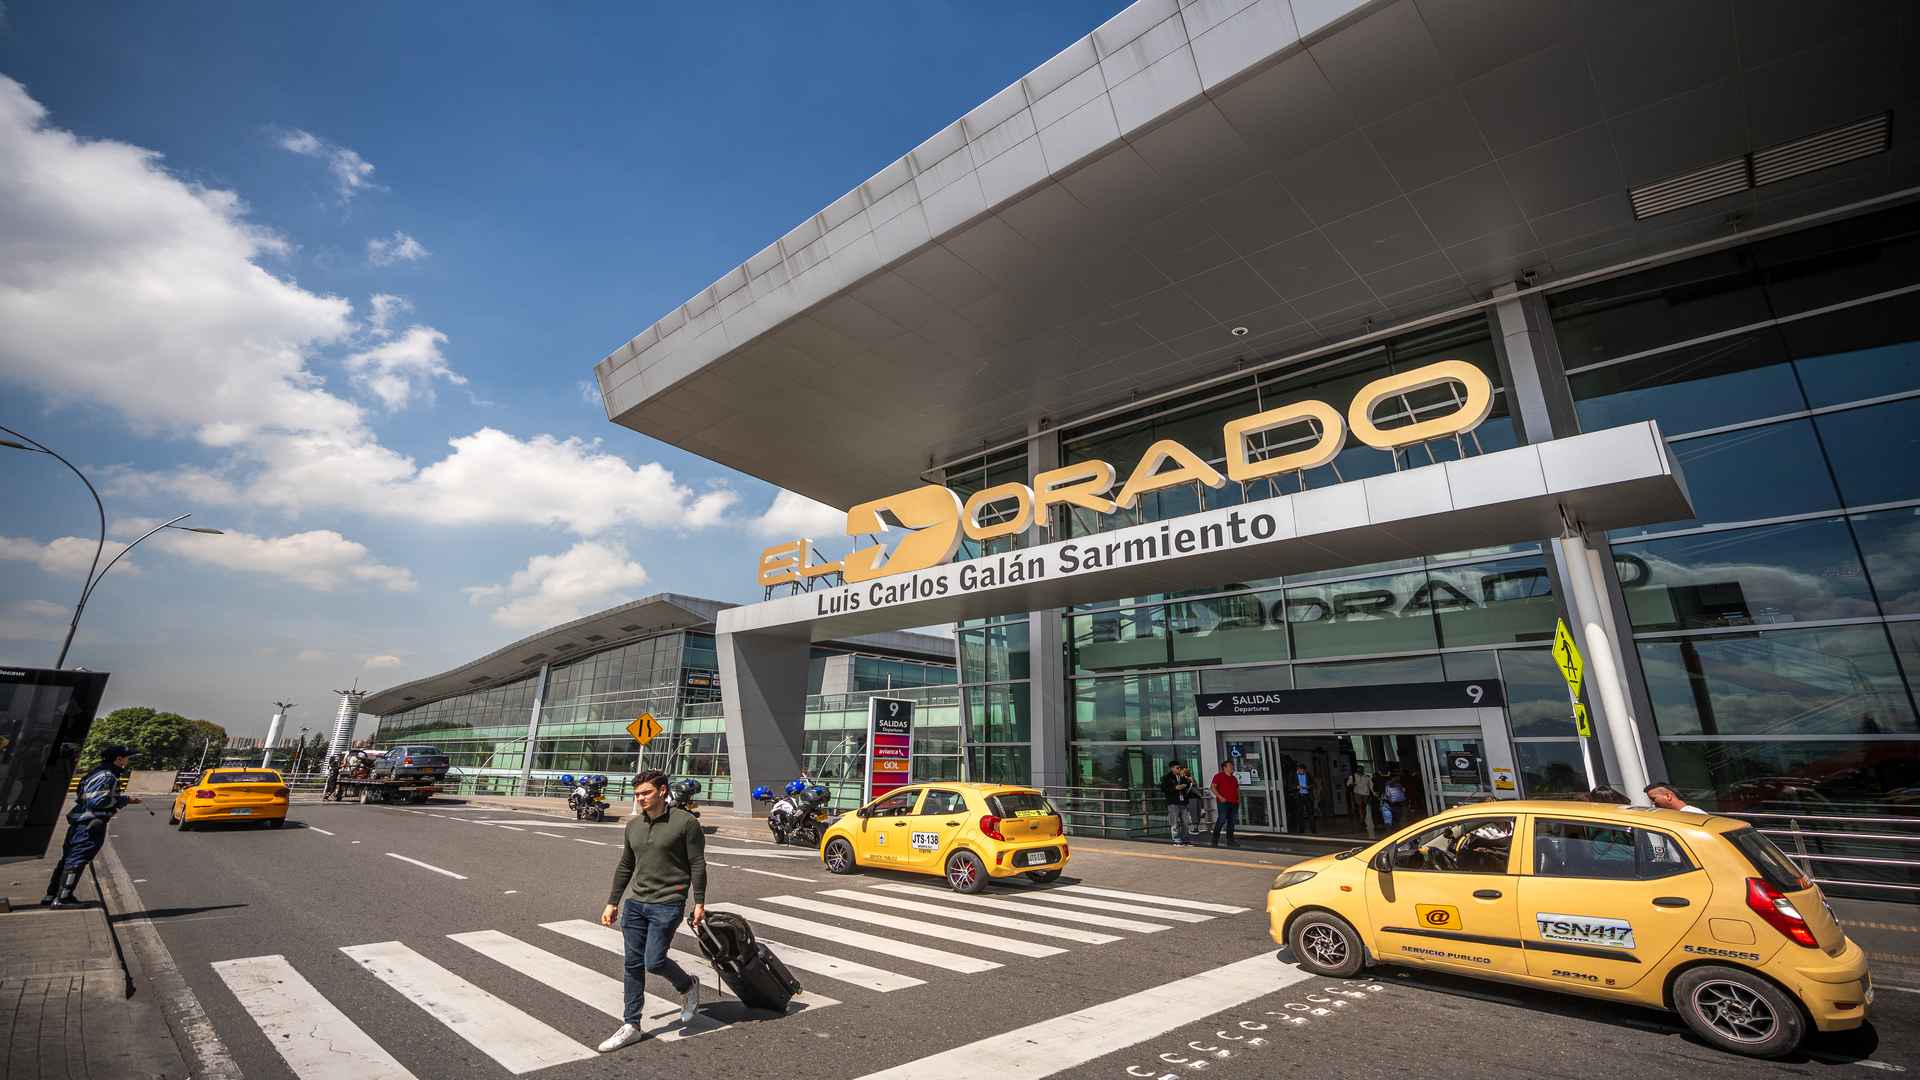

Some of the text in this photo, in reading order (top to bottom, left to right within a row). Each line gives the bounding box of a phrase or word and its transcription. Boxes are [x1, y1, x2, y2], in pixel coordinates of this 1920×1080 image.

[757, 537, 845, 586] EL
[817, 511, 1277, 616] Luis Carlos Galán Sarmiento
[1232, 684, 1485, 705] SALIDAS 9
[889, 702, 899, 717] 9
[879, 719, 908, 728] SALIDAS
[883, 761, 900, 769] GOL
[1537, 919, 1633, 942] TSN417
[1401, 945, 1491, 964] SERVICIO PUBLICO
